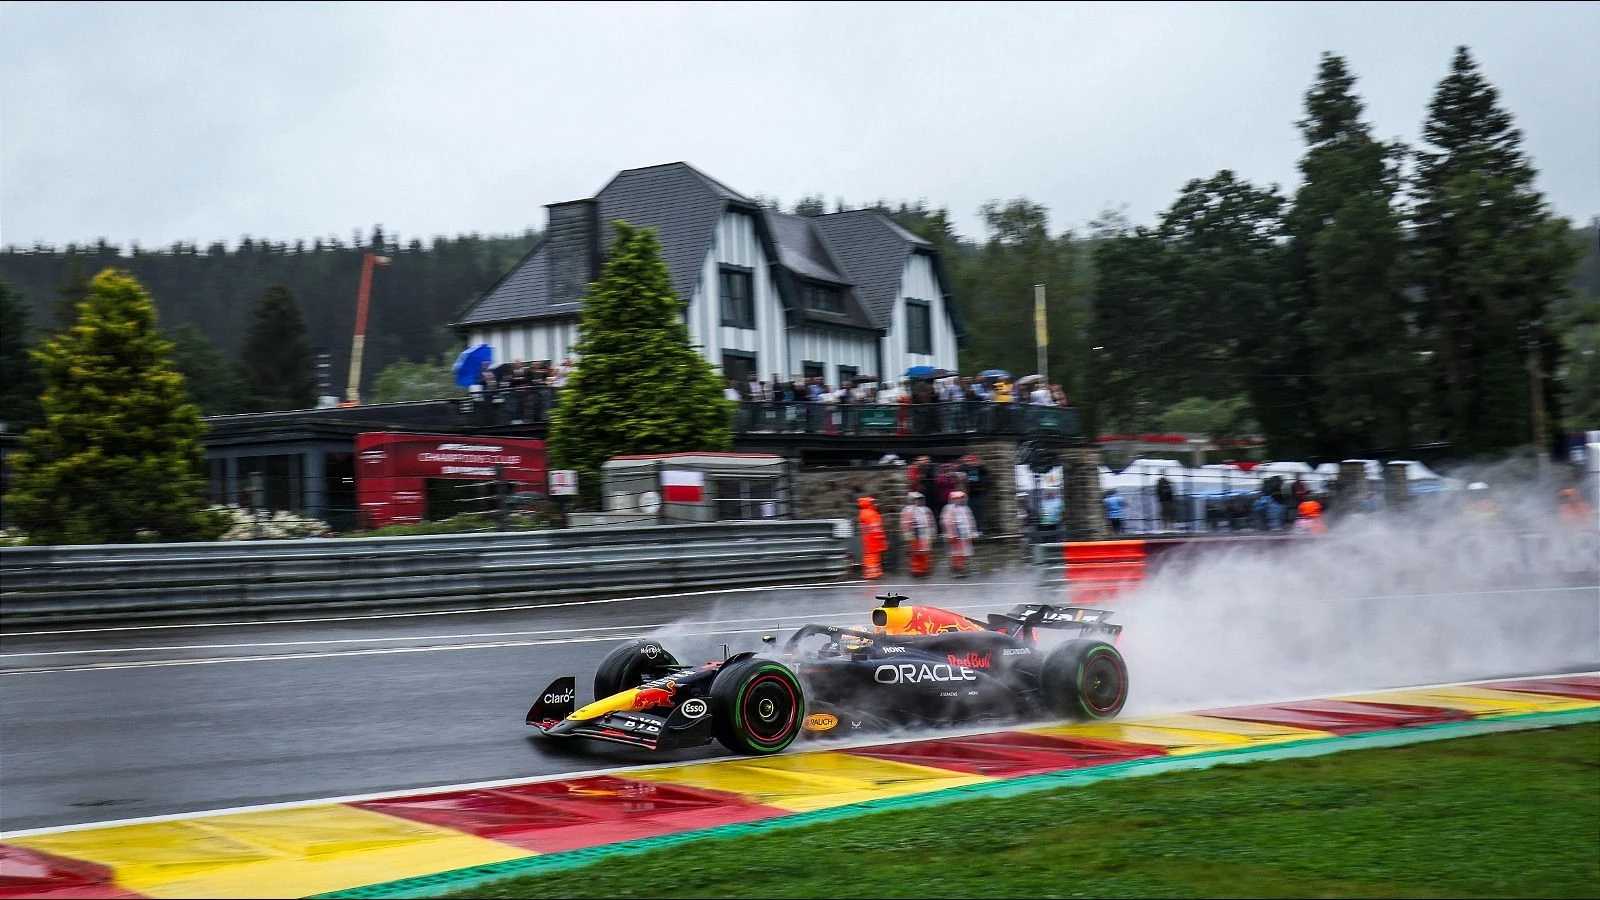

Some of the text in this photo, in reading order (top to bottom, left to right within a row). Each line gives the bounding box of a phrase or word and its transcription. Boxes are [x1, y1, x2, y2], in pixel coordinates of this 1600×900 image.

[1002, 647, 1031, 655] HONDA
[875, 664, 977, 684] ORACLE
[686, 703, 703, 712] Esso
